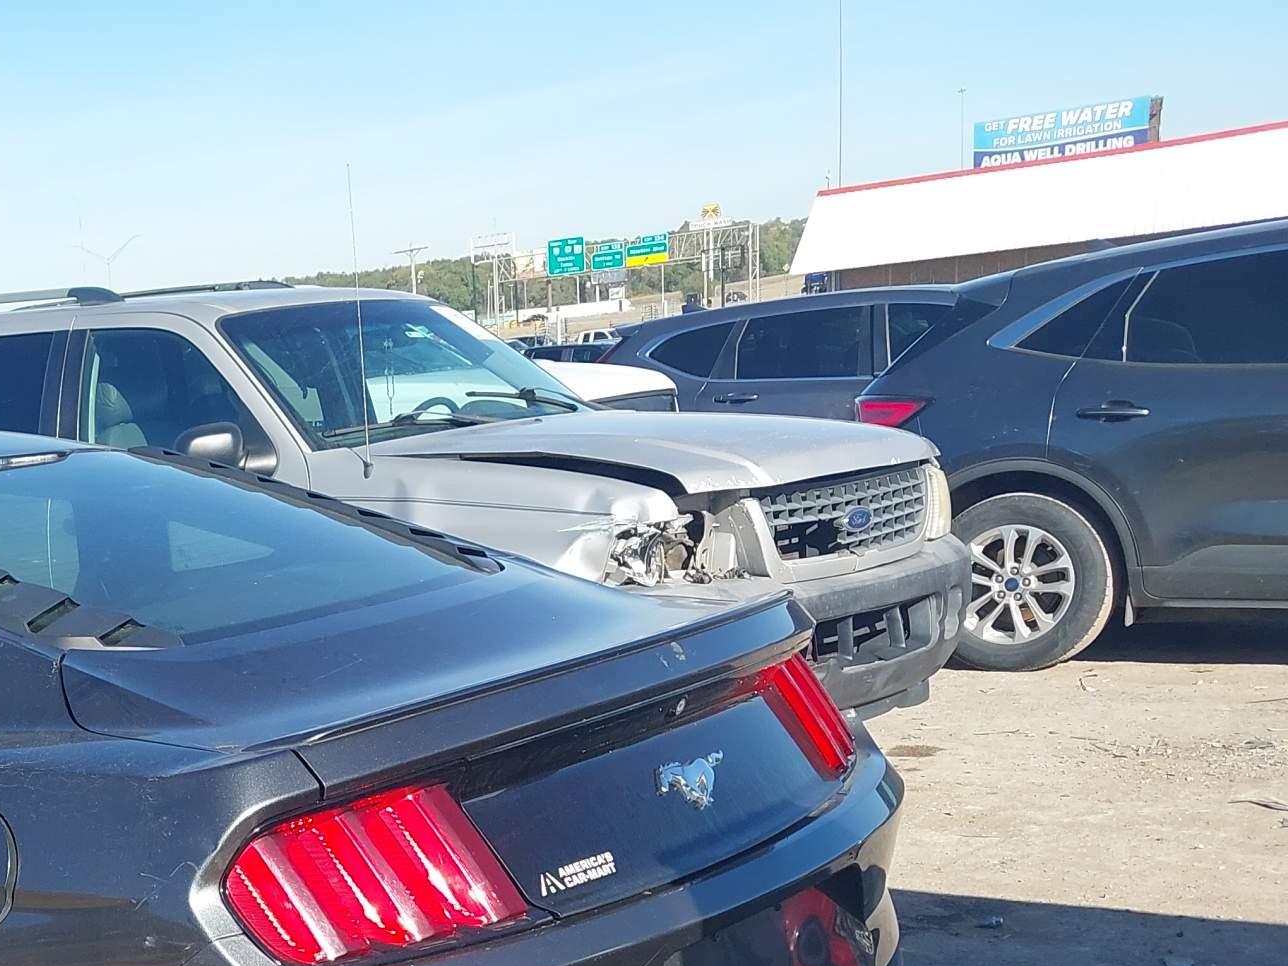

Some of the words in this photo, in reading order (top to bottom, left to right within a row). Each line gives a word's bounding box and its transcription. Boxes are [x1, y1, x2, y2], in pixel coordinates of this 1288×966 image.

[984, 122, 1005, 132] GET
[1006, 113, 1057, 134] FREE
[1062, 101, 1133, 125] WATER
[993, 136, 1014, 148] FOR
[1017, 130, 1052, 144] LAWN
[1053, 120, 1122, 139] IRRIGATION
[980, 153, 1024, 168] AQUA
[1024, 146, 1063, 162] WELL
[1064, 135, 1135, 156] DRILLING
[558, 851, 614, 878] AMERICA'S
[563, 862, 617, 888] CAR-MART
